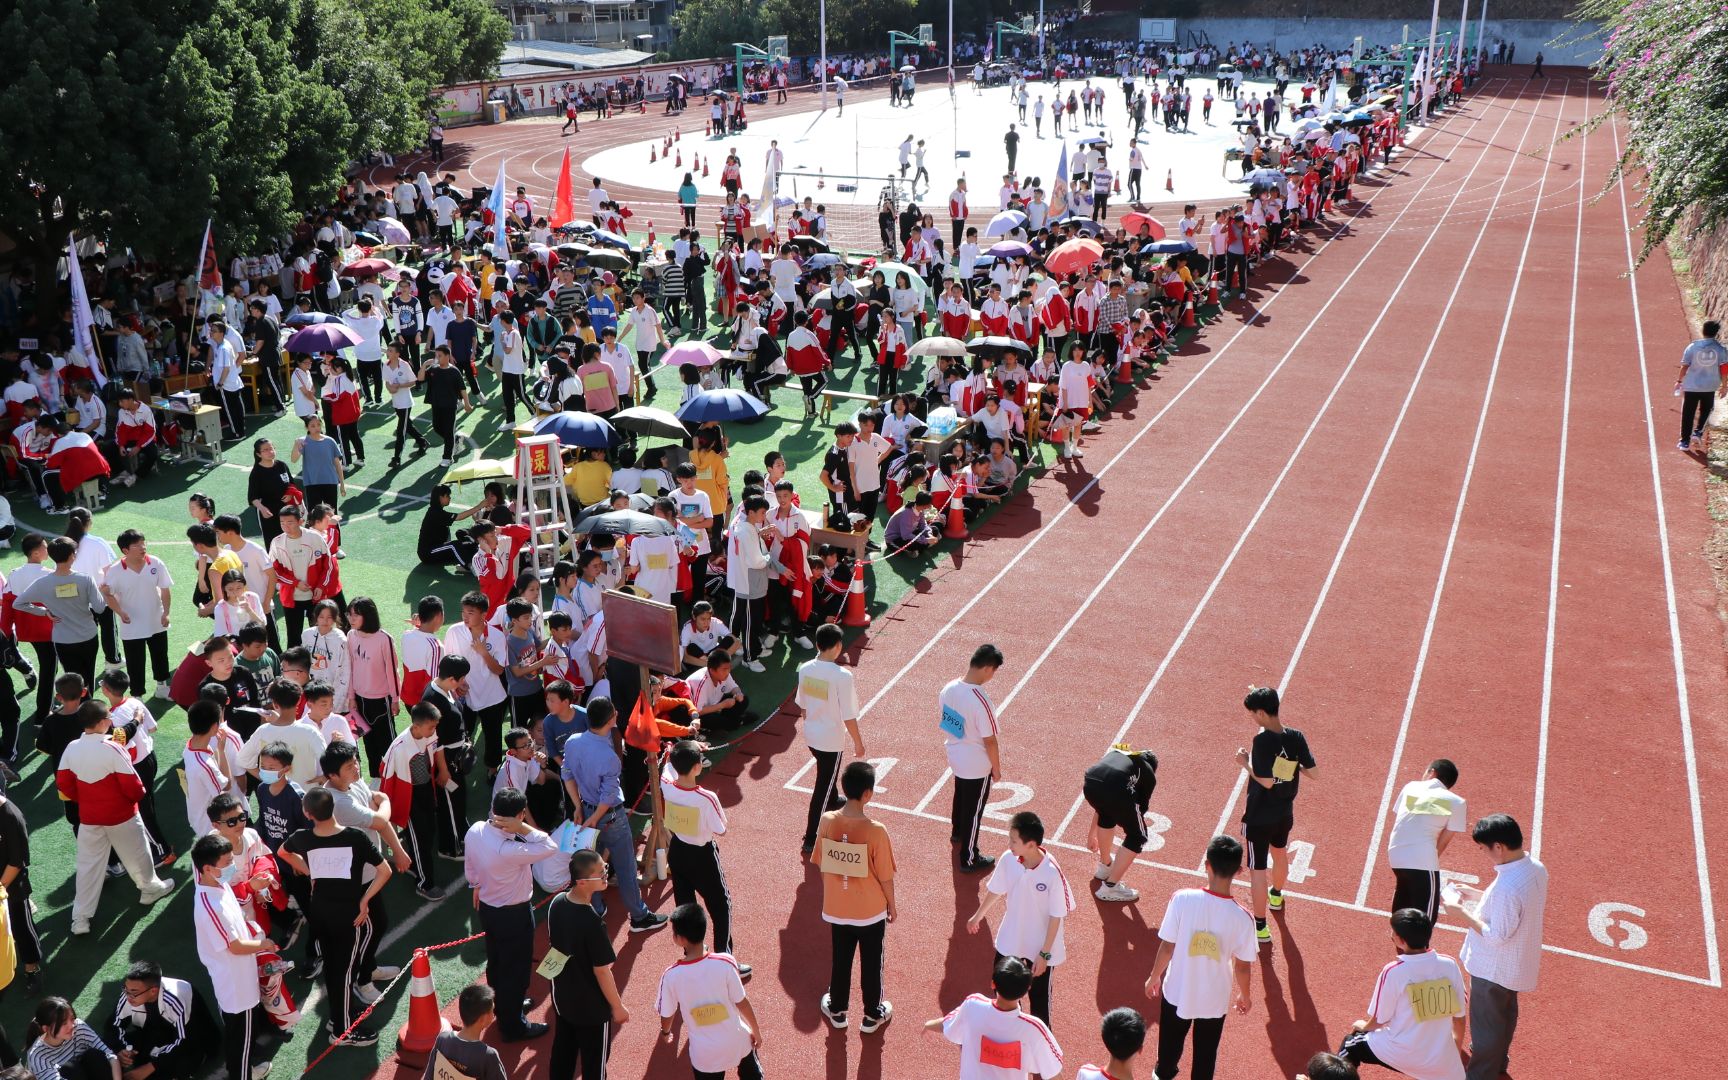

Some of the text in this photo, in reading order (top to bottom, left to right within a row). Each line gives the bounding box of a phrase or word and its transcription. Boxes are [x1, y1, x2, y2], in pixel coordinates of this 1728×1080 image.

[983, 781, 1035, 822] 2
[827, 849, 861, 864] 40202
[1587, 901, 1648, 950] 6
[1412, 984, 1452, 1017] 41001
